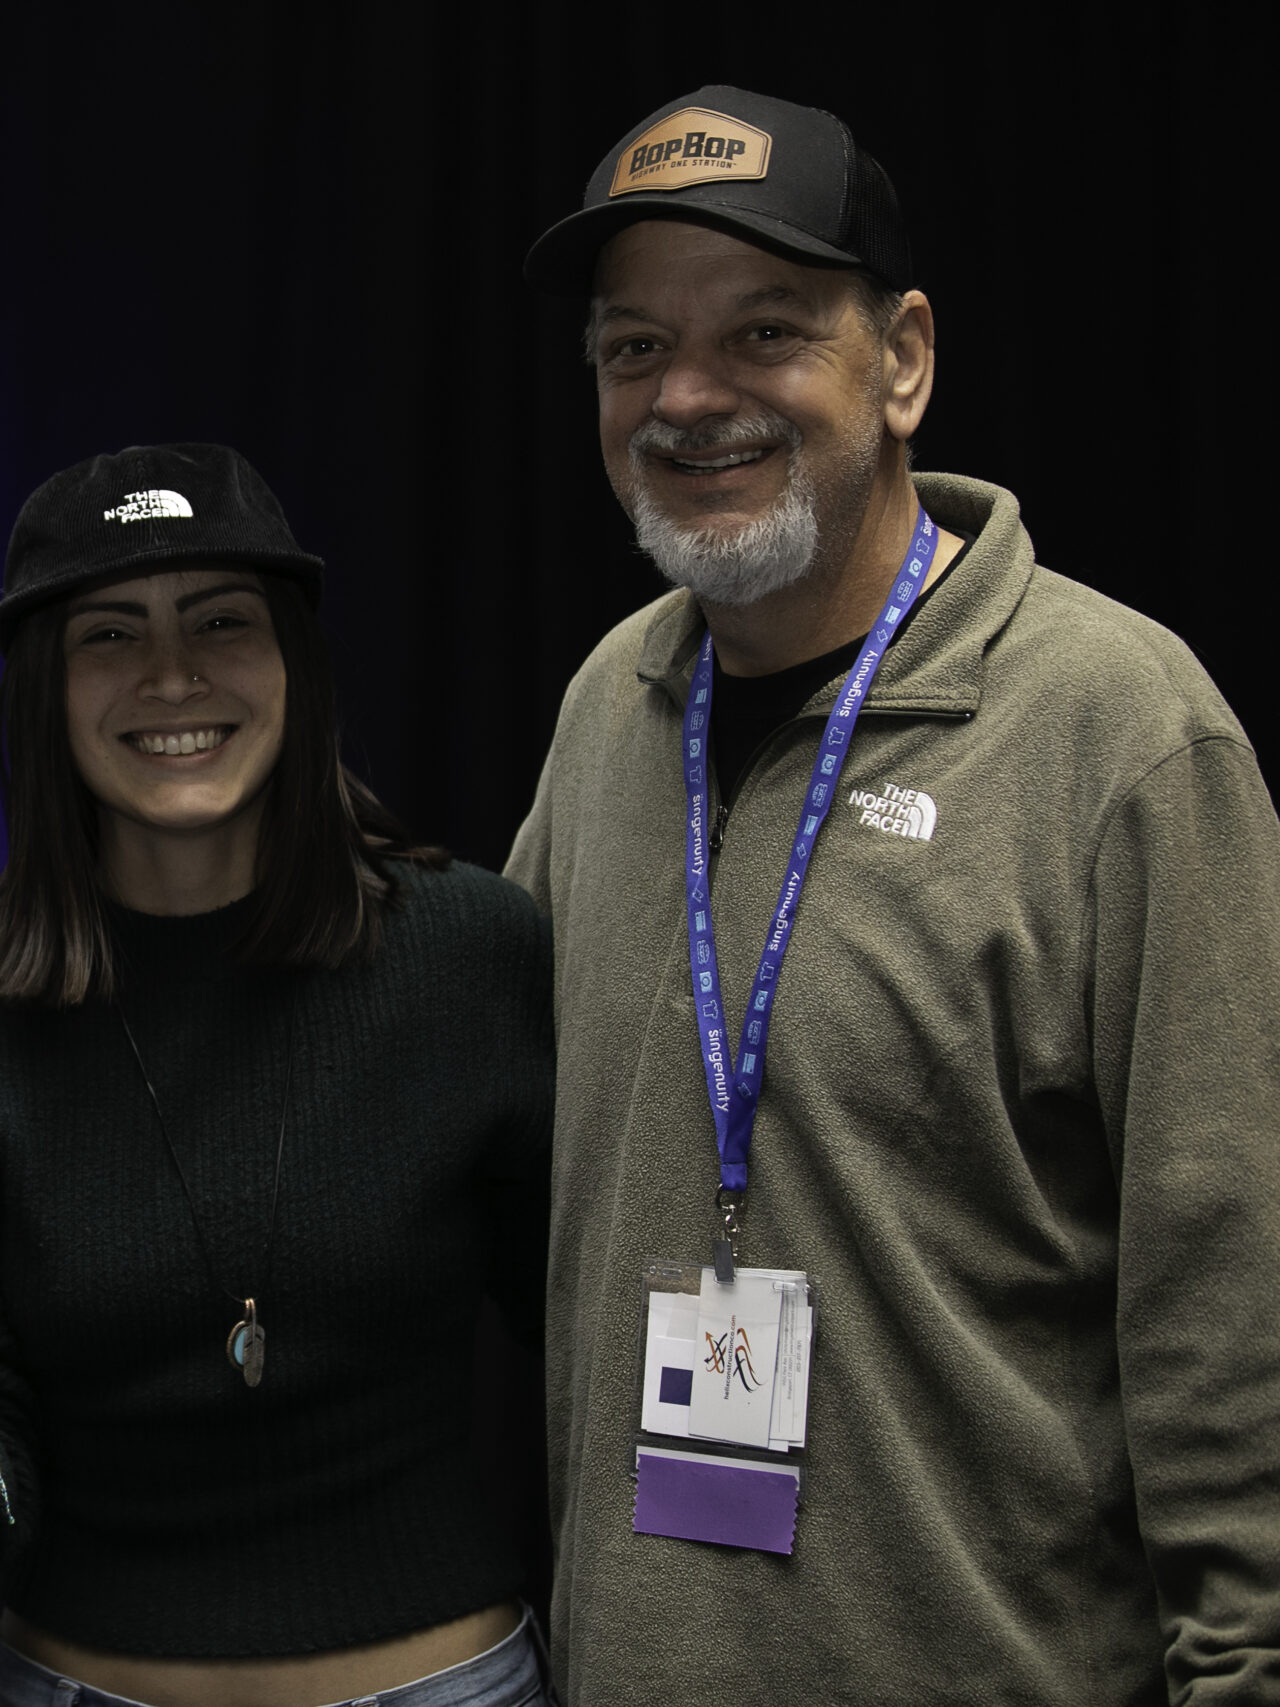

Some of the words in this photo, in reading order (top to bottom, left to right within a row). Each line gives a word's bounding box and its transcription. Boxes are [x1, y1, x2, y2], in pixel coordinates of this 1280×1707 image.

[670, 160, 687, 168] ONE
[124, 490, 159, 502] THE
[104, 500, 161, 520] NORTH
[121, 508, 161, 523] FACE
[839, 650, 878, 717] singenuity
[849, 790, 911, 819] NORTH
[884, 783, 917, 805] THE
[859, 810, 903, 834] FACE
[691, 795, 705, 875] singenuity
[770, 871, 800, 951] singenuity
[709, 1030, 729, 1112] singenuity
